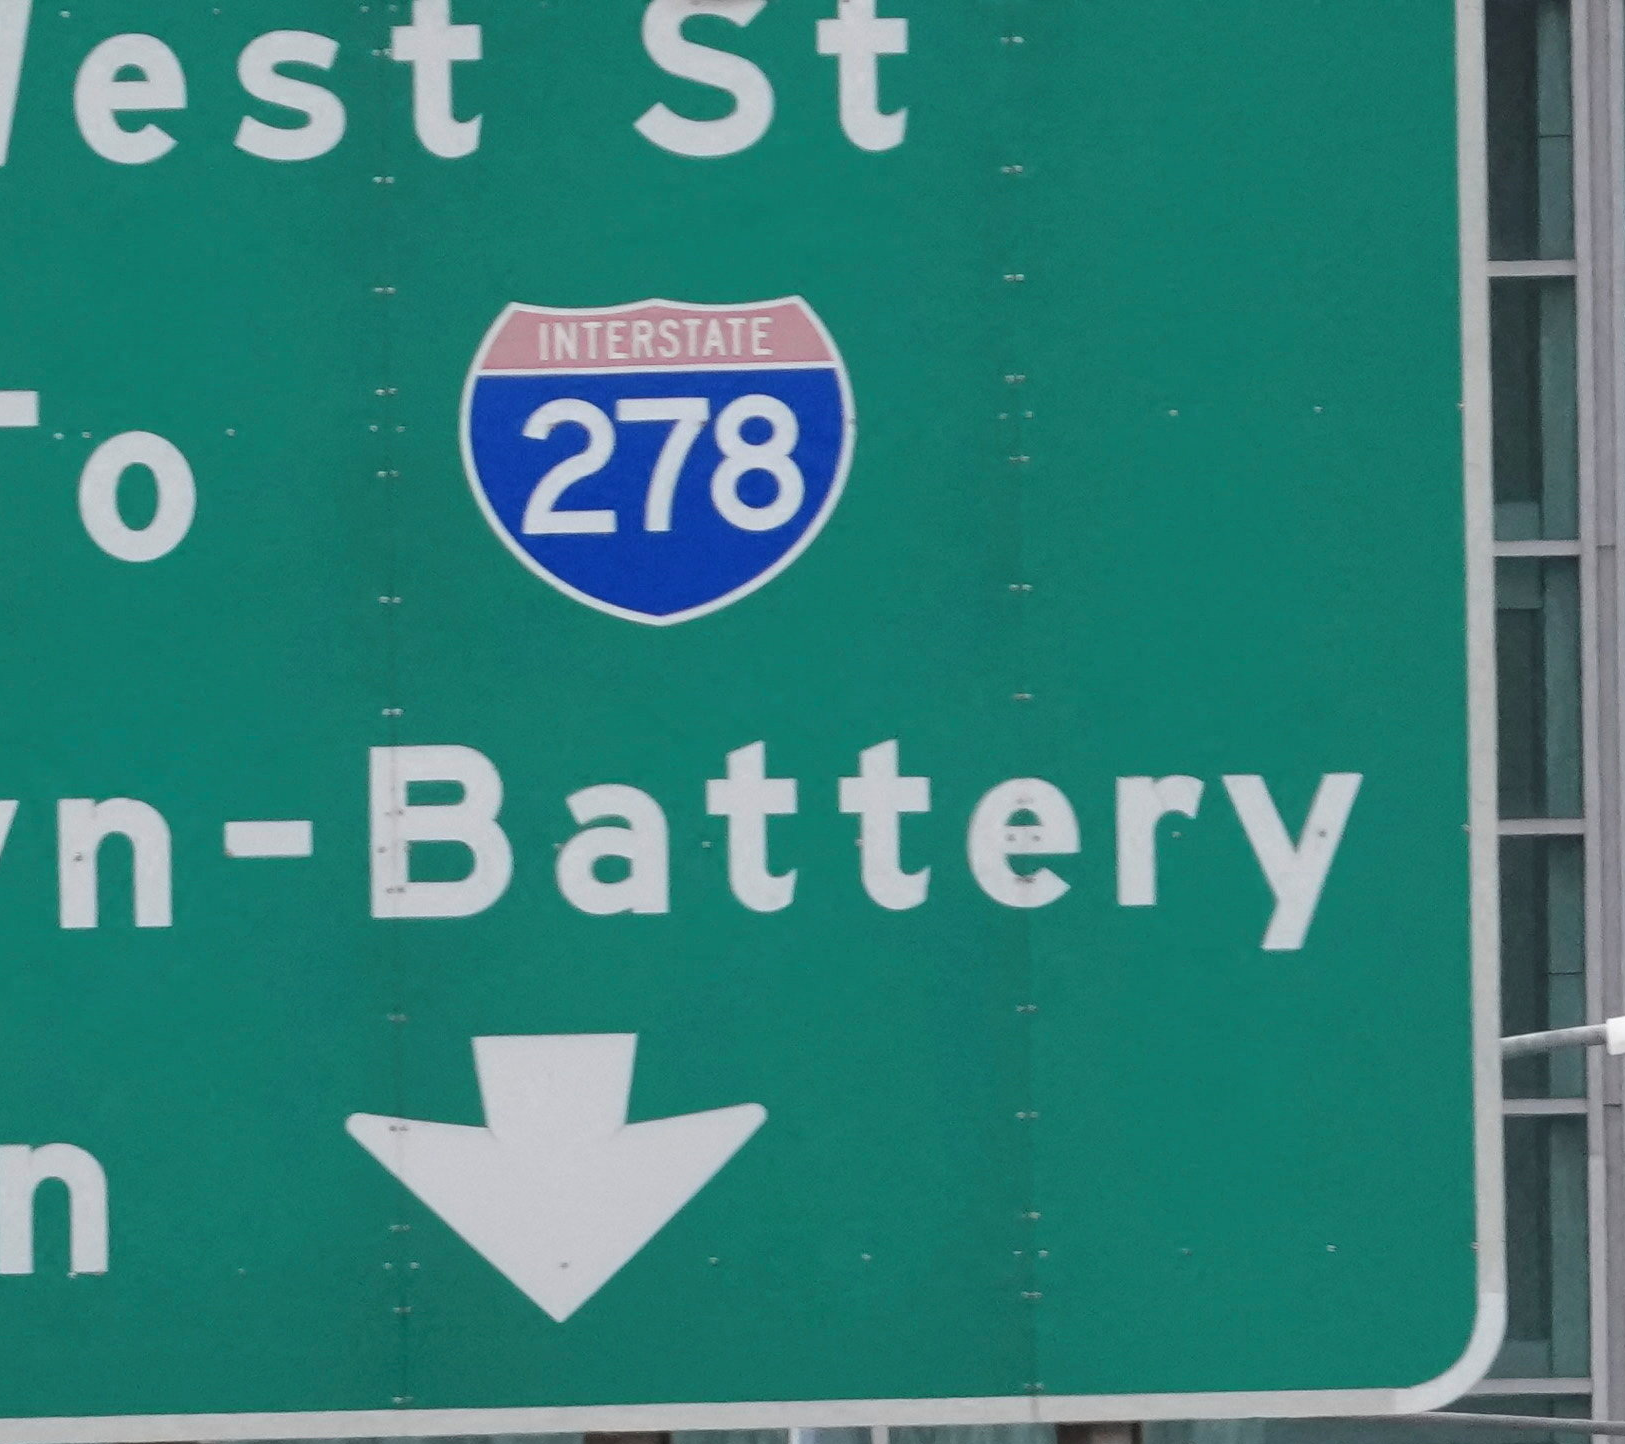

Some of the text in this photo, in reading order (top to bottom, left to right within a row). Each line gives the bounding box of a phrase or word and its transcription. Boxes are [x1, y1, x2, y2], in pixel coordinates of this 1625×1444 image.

[634, 0, 907, 157] St
[539, 317, 773, 360] INTERSTATE
[522, 394, 805, 534] 278
